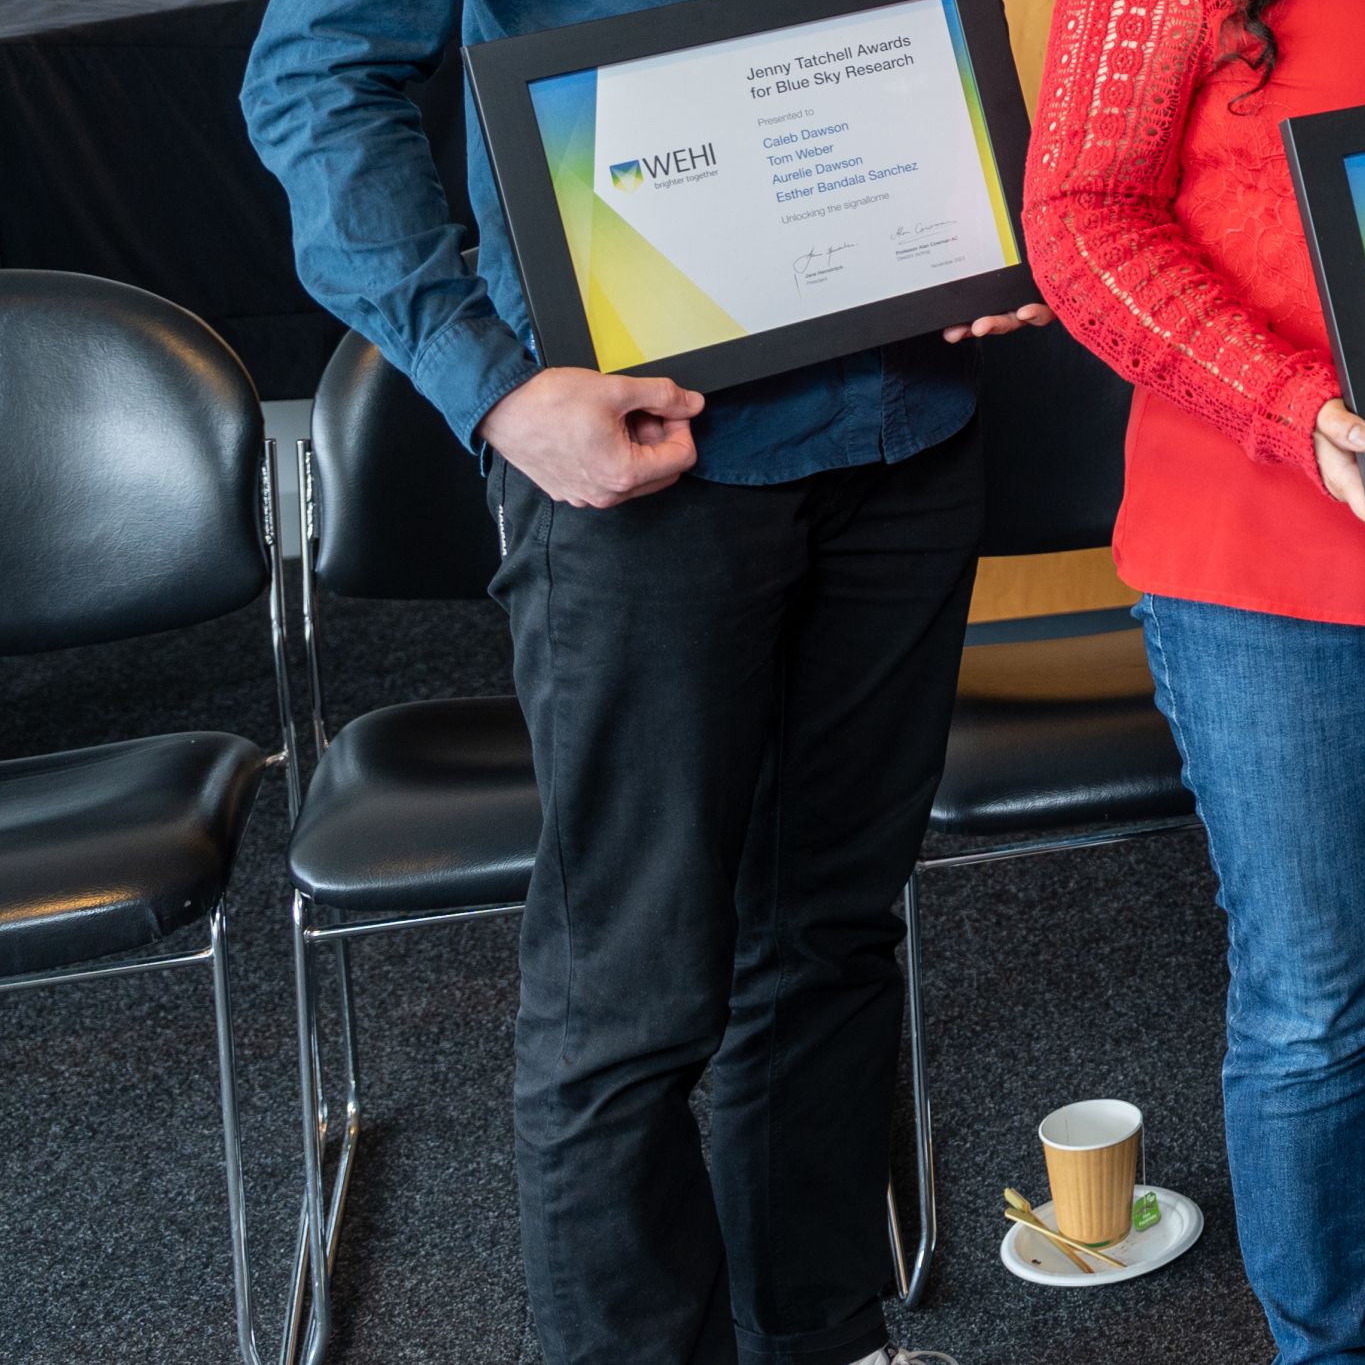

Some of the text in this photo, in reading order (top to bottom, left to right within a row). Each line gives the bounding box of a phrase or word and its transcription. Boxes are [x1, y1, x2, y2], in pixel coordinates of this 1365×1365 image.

[746, 36, 911, 81] Jenny Tatchell Awards
[750, 54, 914, 99] for Blue Sky Research
[757, 107, 815, 127] Presented to
[763, 122, 849, 149] Caleb Dawson
[642, 142, 717, 179] WEHI
[766, 143, 834, 166] Tom Weber
[772, 155, 863, 185] Aurelie Dawson
[654, 169, 719, 190] brighter together
[776, 162, 919, 203] Esther Bandala Sanchez
[780, 192, 890, 225] Unlocking the signallome
